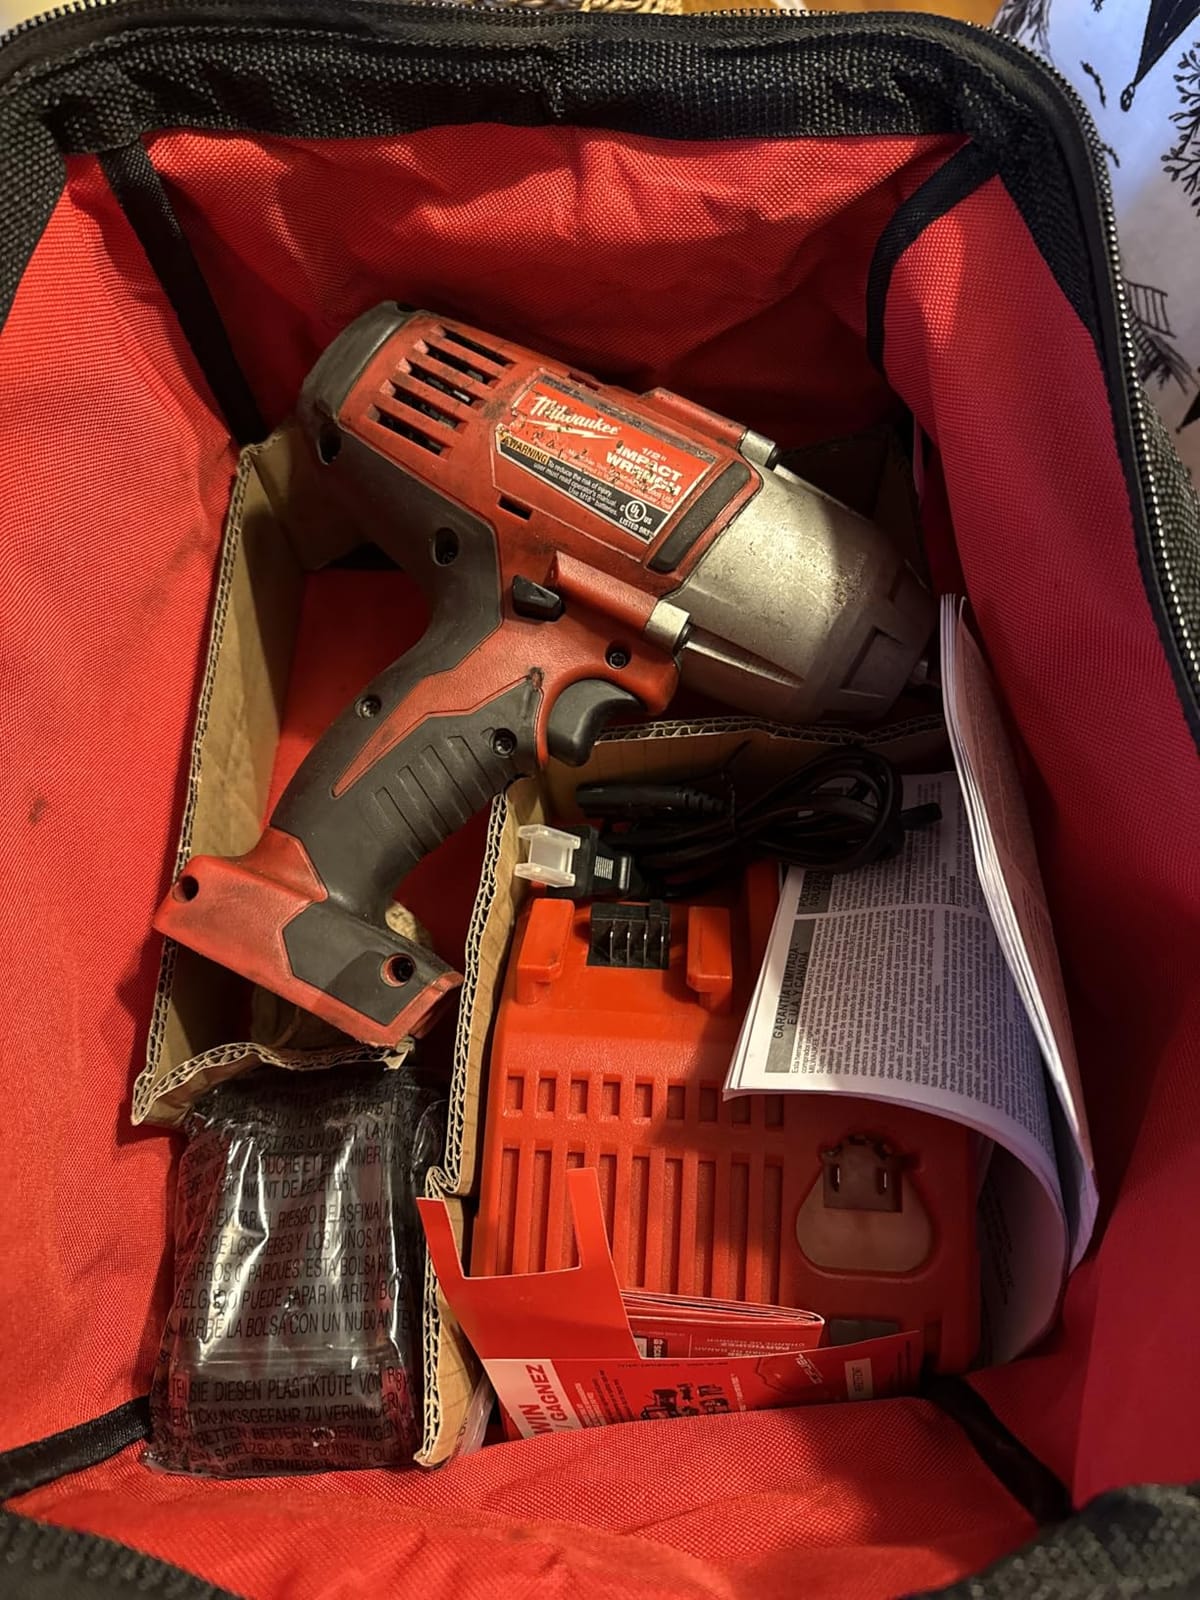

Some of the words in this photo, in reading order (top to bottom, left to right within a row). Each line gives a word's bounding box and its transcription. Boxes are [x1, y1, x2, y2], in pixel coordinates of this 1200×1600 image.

[530, 396, 621, 434] Milwaukee
[508, 438, 549, 464] WARNING
[616, 445, 683, 481] IMPACT
[606, 451, 682, 496] WRENCH
[278, 1204, 317, 1229] RIESGO
[305, 1256, 337, 1279] ESTA
[341, 1254, 376, 1277] BOLSA
[242, 1286, 284, 1311] PUEDE
[286, 1284, 327, 1308] TAPAR
[331, 1281, 370, 1305] NARIZ
[226, 1317, 243, 1340] LA
[245, 1314, 288, 1338] BOLSA
[289, 1311, 319, 1335] CON
[321, 1310, 341, 1334] UN
[525, 1365, 569, 1422] GAGNEZ
[519, 1404, 554, 1435] WIN
